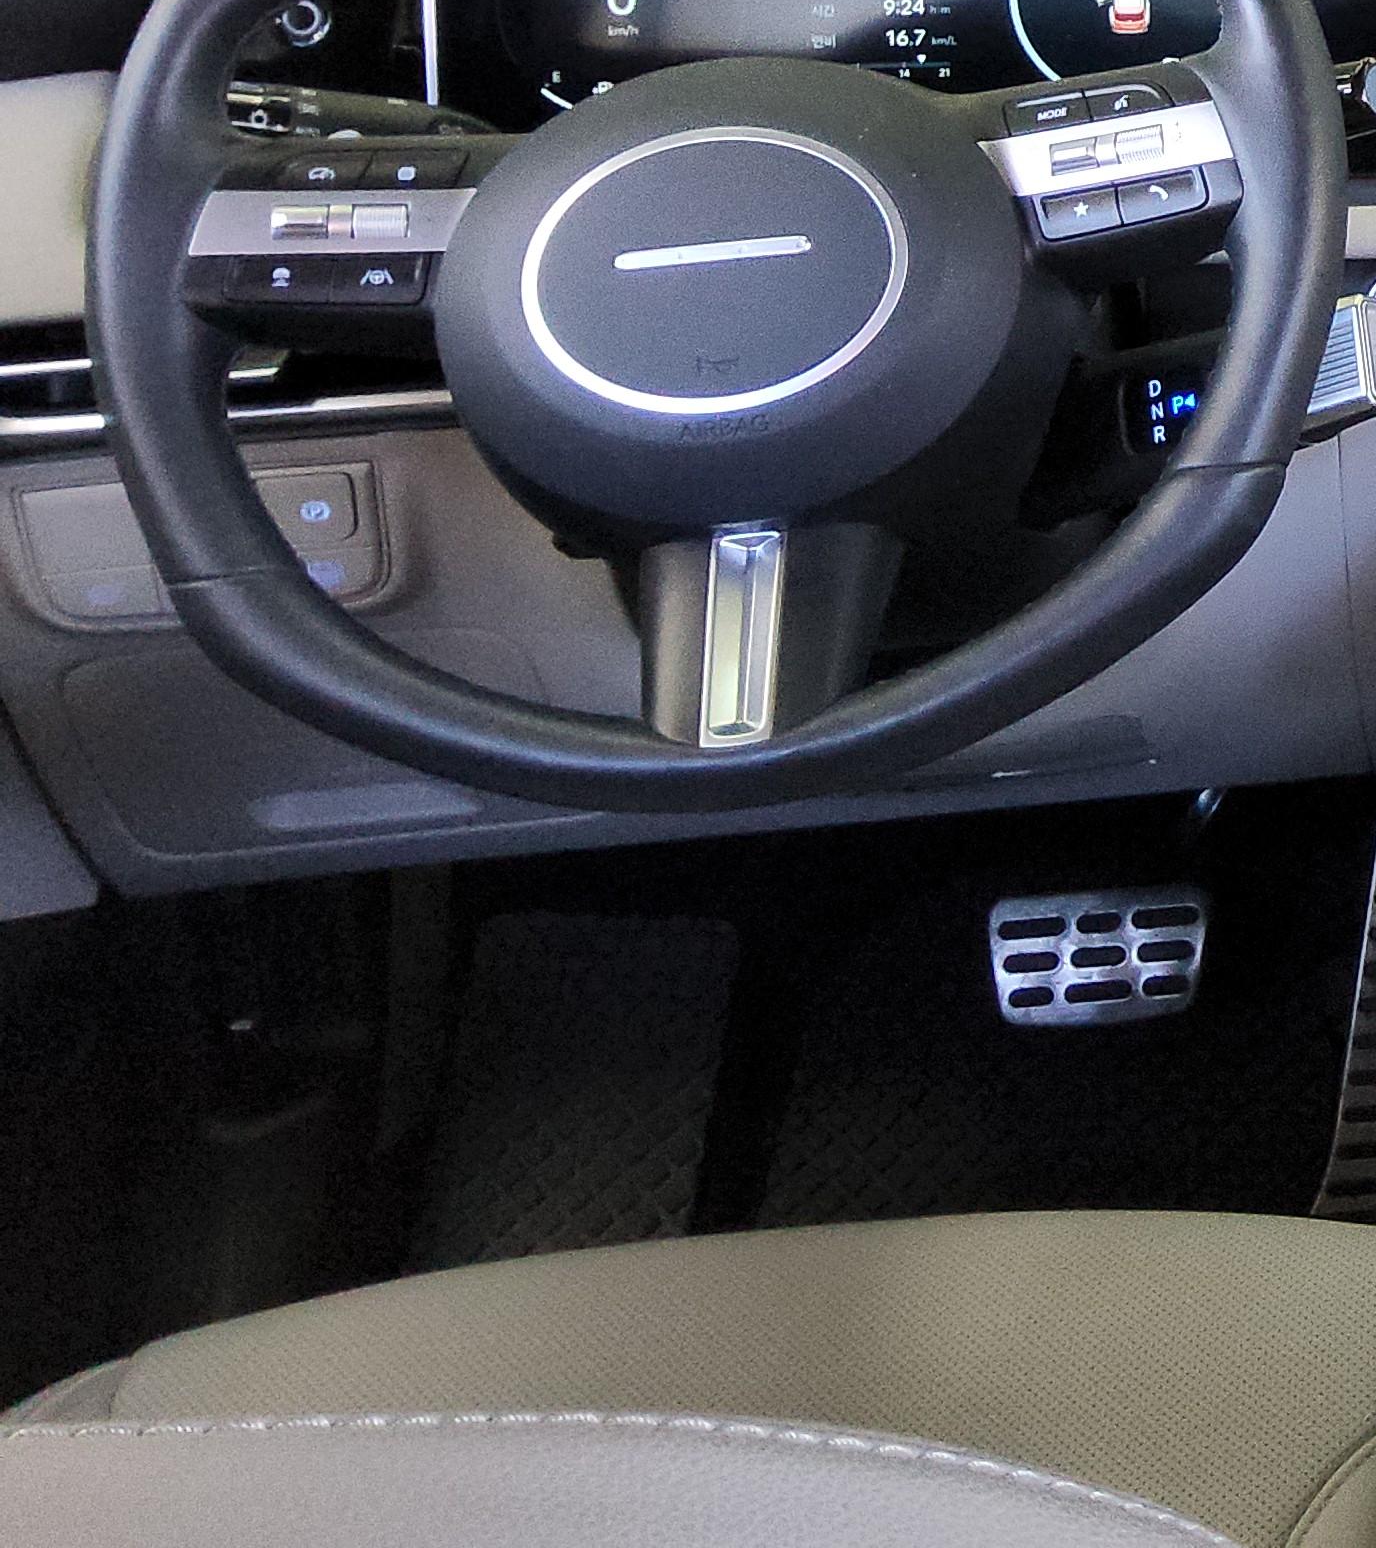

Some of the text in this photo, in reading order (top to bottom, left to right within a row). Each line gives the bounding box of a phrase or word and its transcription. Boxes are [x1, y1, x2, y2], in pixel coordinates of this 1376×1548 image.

[885, 29, 926, 47] 16.7
[899, 68, 911, 78] 14
[938, 68, 950, 78] 21
[1036, 106, 1067, 121] MODE
[1147, 379, 1162, 398] D
[1150, 401, 1164, 421] N
[1172, 395, 1184, 415] P
[678, 414, 770, 441] AIRBAG
[1153, 424, 1166, 444] R
